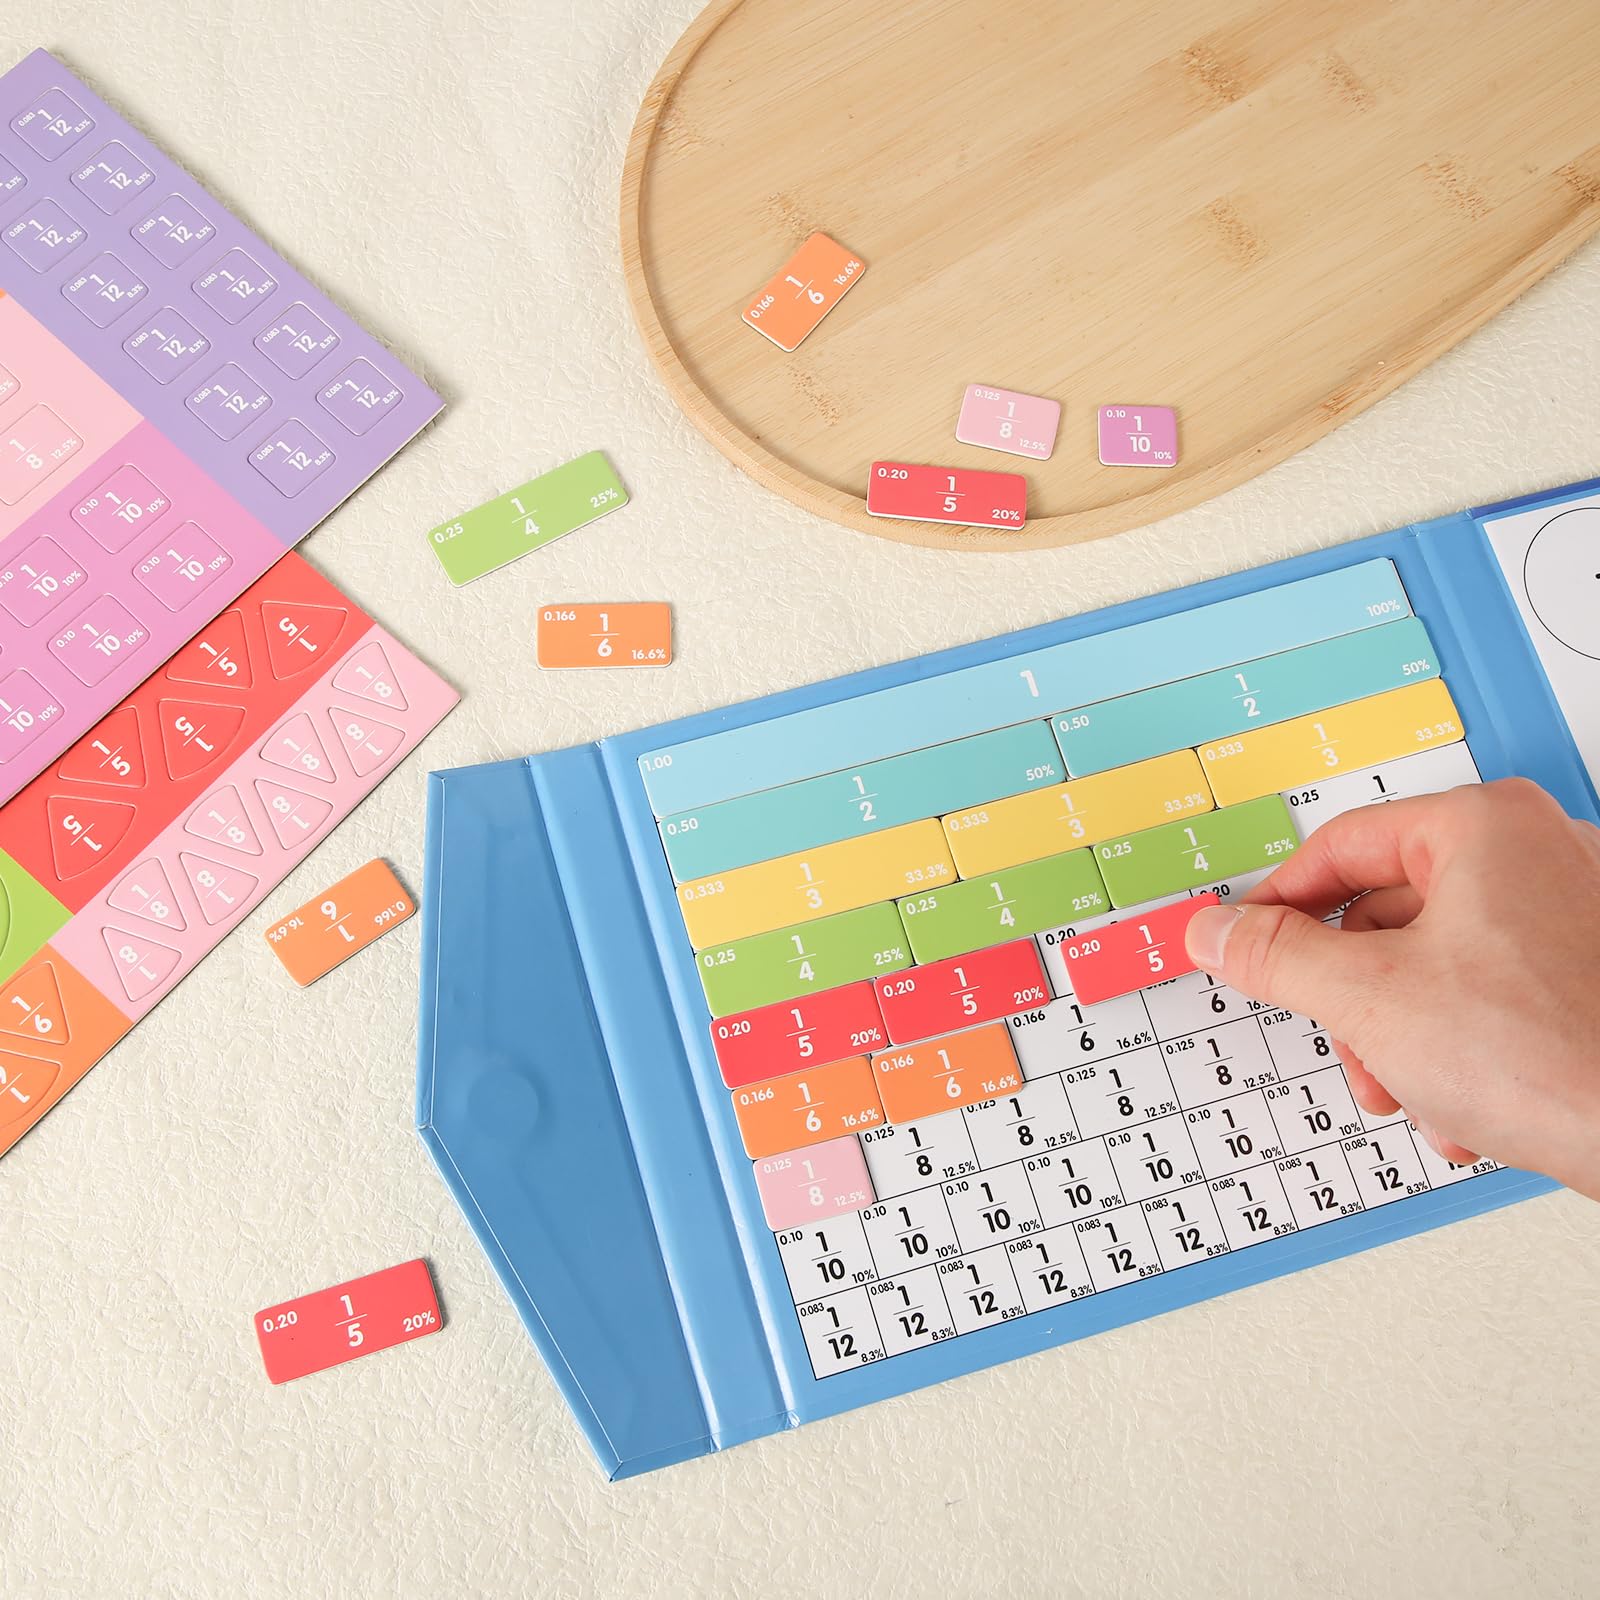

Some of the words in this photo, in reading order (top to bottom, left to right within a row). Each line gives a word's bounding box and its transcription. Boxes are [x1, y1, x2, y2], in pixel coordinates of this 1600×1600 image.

[74, 119, 90, 133] 8.3%
[833, 260, 860, 285] 16.6%
[257, 280, 273, 294] 8.3%
[750, 295, 774, 318] 0.166
[382, 389, 399, 404] 8.3%
[975, 388, 1000, 400] 0.125
[1106, 409, 1126, 418] 0.10
[1019, 438, 1046, 451] 12.5%
[1154, 451, 1172, 459] 10%
[878, 468, 908, 479] 0.20
[146, 498, 165, 513] 10%
[590, 488, 618, 508] 25%
[79, 499, 98, 515] 0.10
[992, 509, 1020, 520] 20%
[434, 523, 464, 543] 0.25
[141, 556, 160, 573] 0.10
[208, 555, 227, 570] 10%
[544, 611, 576, 621] 0.166
[1366, 600, 1401, 617] 100%
[632, 649, 666, 659] 16.6%
[1402, 659, 1430, 675] 50%
[1060, 715, 1089, 732] 0.50
[1416, 721, 1457, 741] 33.3%
[1206, 741, 1244, 760] 0.333
[643, 755, 672, 772] 1.00
[1026, 764, 1055, 781] 50%
[1165, 793, 1207, 813] 33.3%
[1290, 789, 1319, 806] 0.25
[667, 818, 698, 835] 0.50
[950, 812, 989, 832] 0.333
[1102, 841, 1132, 859] 0.25
[1264, 838, 1294, 856] 25%
[905, 864, 948, 884] 33.3%
[684, 881, 724, 900] 0.333
[906, 896, 937, 915] 0.25
[1072, 892, 1102, 911] 25%
[374, 901, 406, 926] 0.166
[269, 917, 304, 942] 16.6%
[704, 949, 736, 967] 0.25
[874, 947, 904, 965] 25%
[1069, 940, 1100, 959] 0.20
[883, 979, 915, 997] 0.20
[1014, 986, 1044, 1004] 20%
[1013, 1010, 1045, 1028] 0.166
[718, 1020, 751, 1039] 0.20
[850, 1028, 881, 1046] 20%
[1116, 1031, 1152, 1050] 16.6%
[880, 1054, 914, 1072] 0.166
[981, 1074, 1018, 1093] 16.6%
[1067, 1067, 1096, 1084] 0.125
[740, 1087, 774, 1105] 0.166
[841, 1108, 879, 1127] 16.6%
[1144, 1101, 1176, 1118] 12.5%
[864, 1126, 894, 1143] 0.125
[1108, 1133, 1131, 1147] 0.10
[763, 1158, 792, 1174] 0.125
[942, 1161, 975, 1178] 12.5%
[1278, 1157, 1302, 1172] 0.083
[1180, 1170, 1202, 1184] 10%
[834, 1190, 866, 1207] 12.5%
[1340, 1201, 1362, 1215] 8.3%
[780, 1230, 803, 1245] 0.10
[852, 1269, 875, 1284] 10%
[870, 1281, 895, 1296] 0.083
[263, 1311, 297, 1332] 0.20
[403, 1310, 435, 1332] 20%
[931, 1327, 954, 1341] 8.3%
